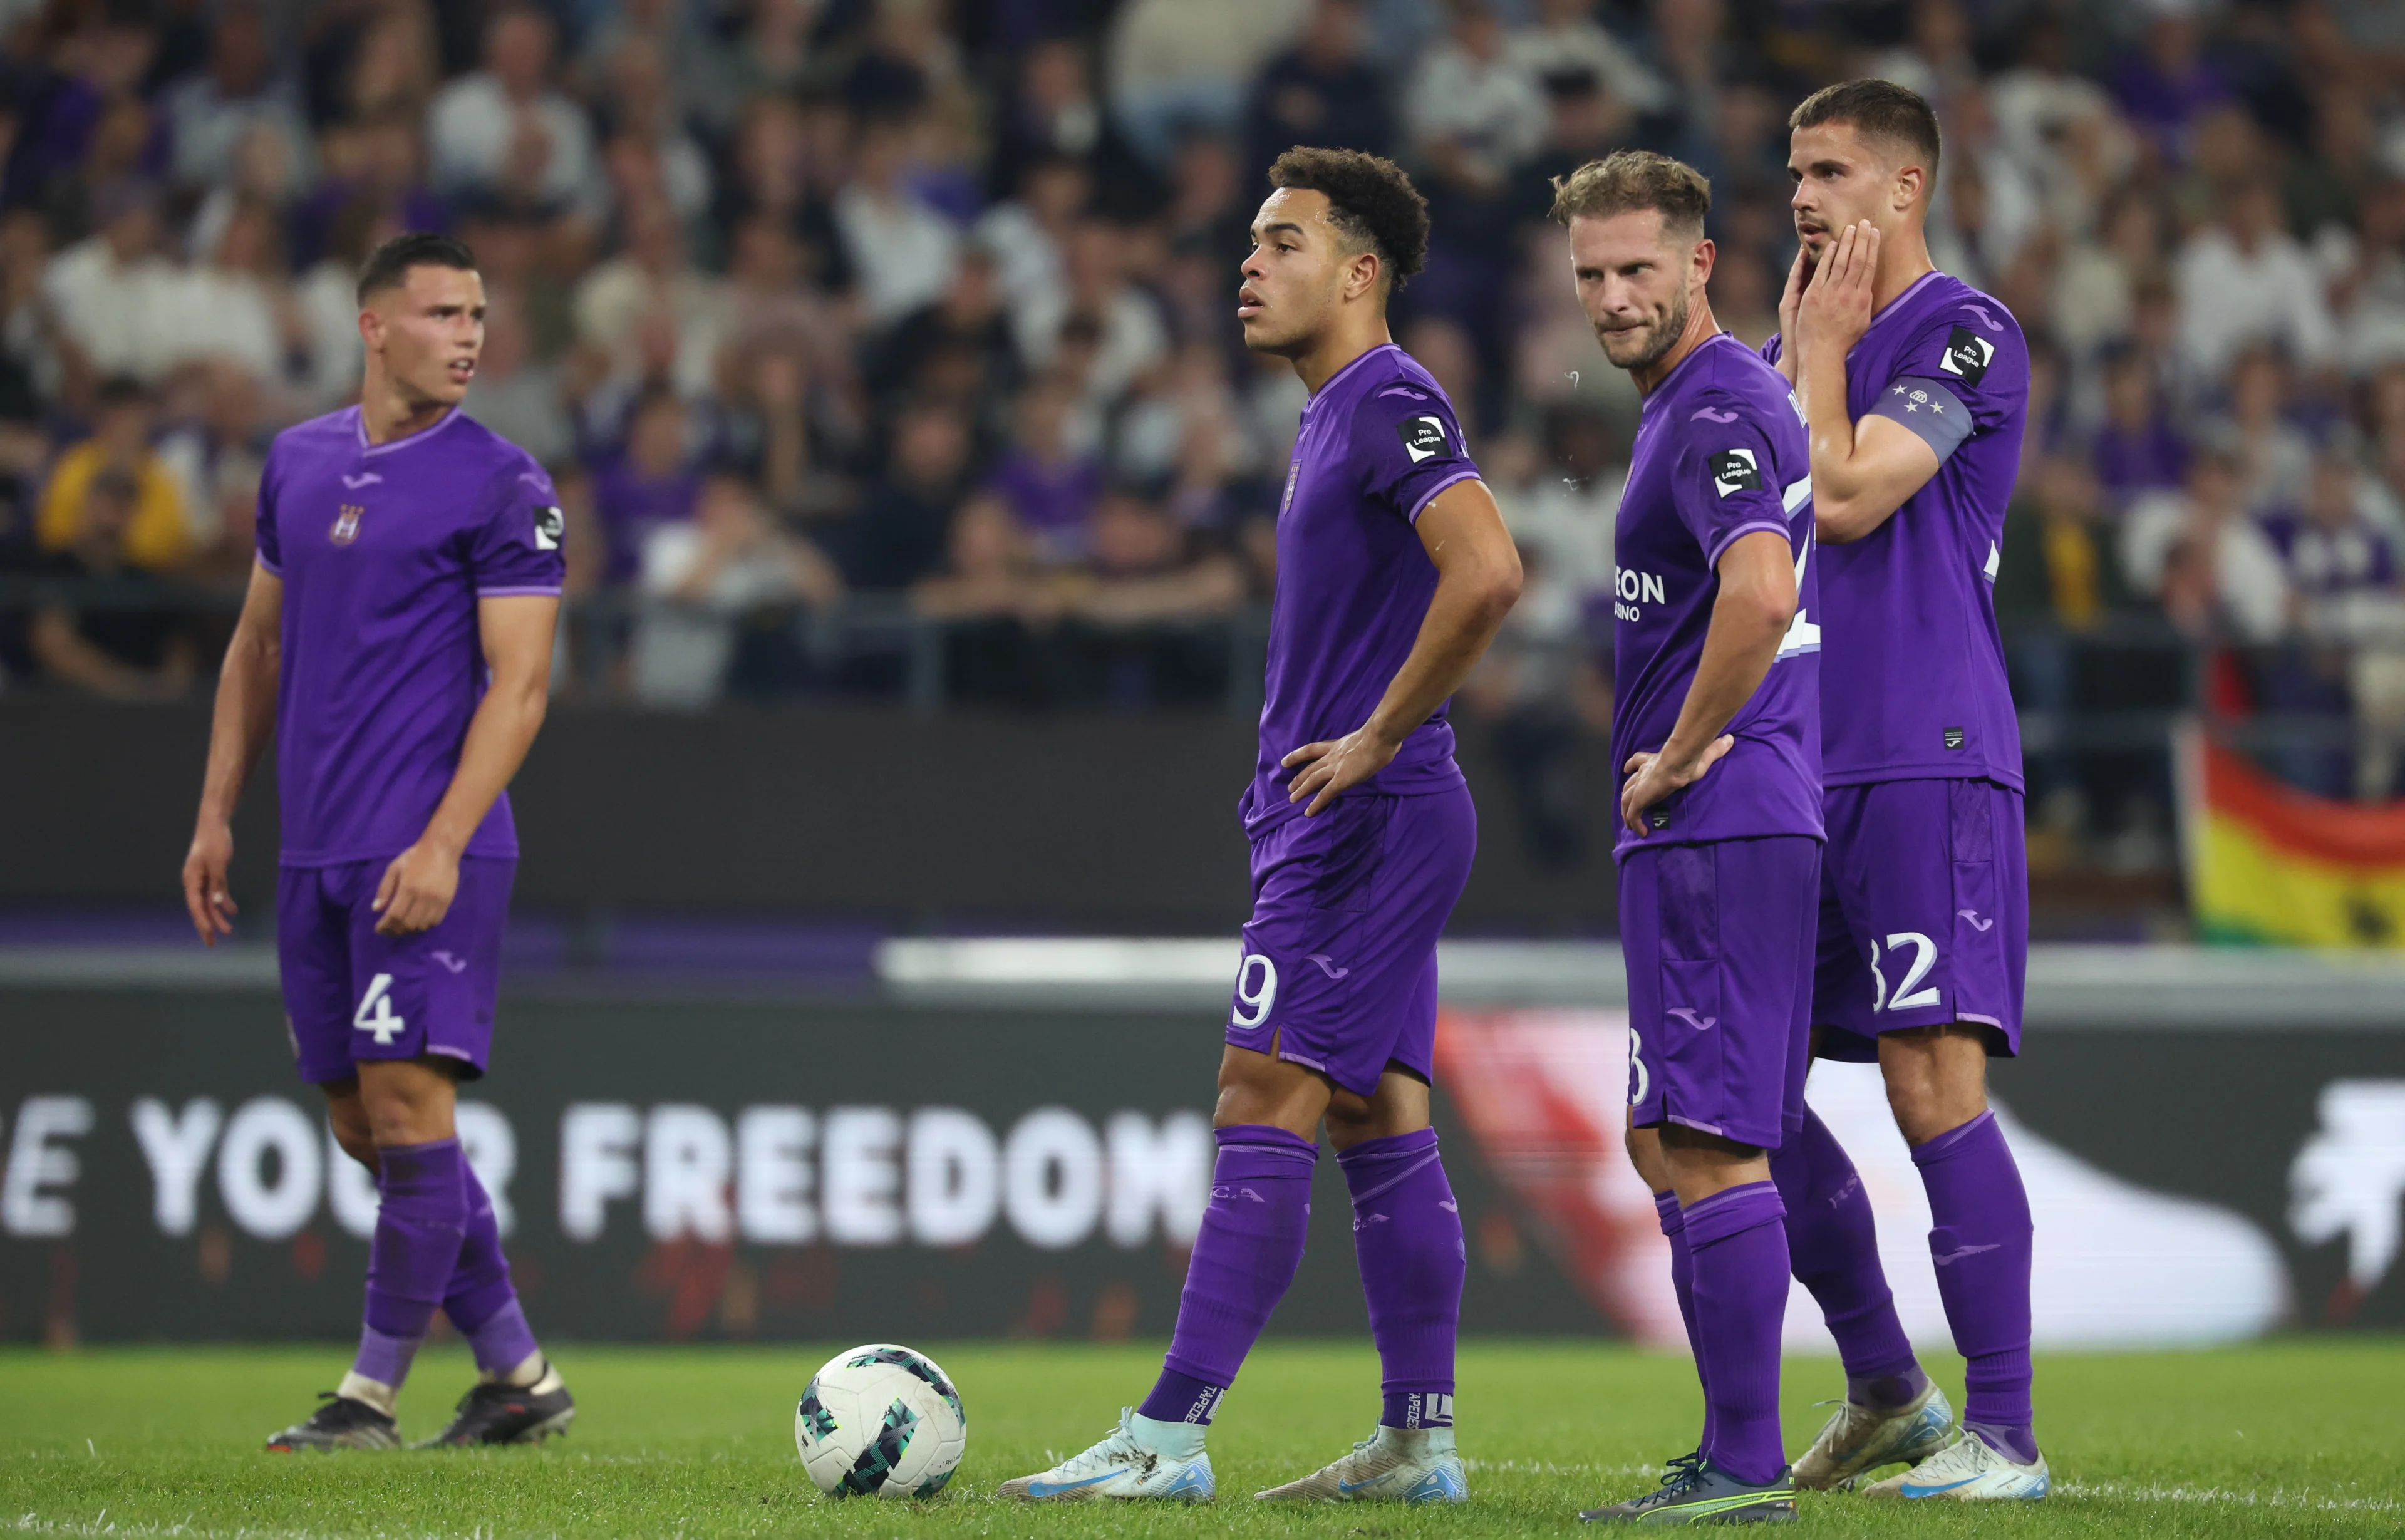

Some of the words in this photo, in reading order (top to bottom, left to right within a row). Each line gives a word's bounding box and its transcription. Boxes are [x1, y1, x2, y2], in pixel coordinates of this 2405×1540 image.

[1954, 349, 1980, 368] League
[1964, 346, 1977, 356] Pro
[1414, 436, 1440, 445] League
[1721, 468, 1751, 480] League
[353, 973, 406, 1045] 4
[561, 1103, 1217, 1248] FREEDOM
[1184, 1386, 1218, 1424] TAPEDE
[1147, 1470, 1162, 1479] Mario
